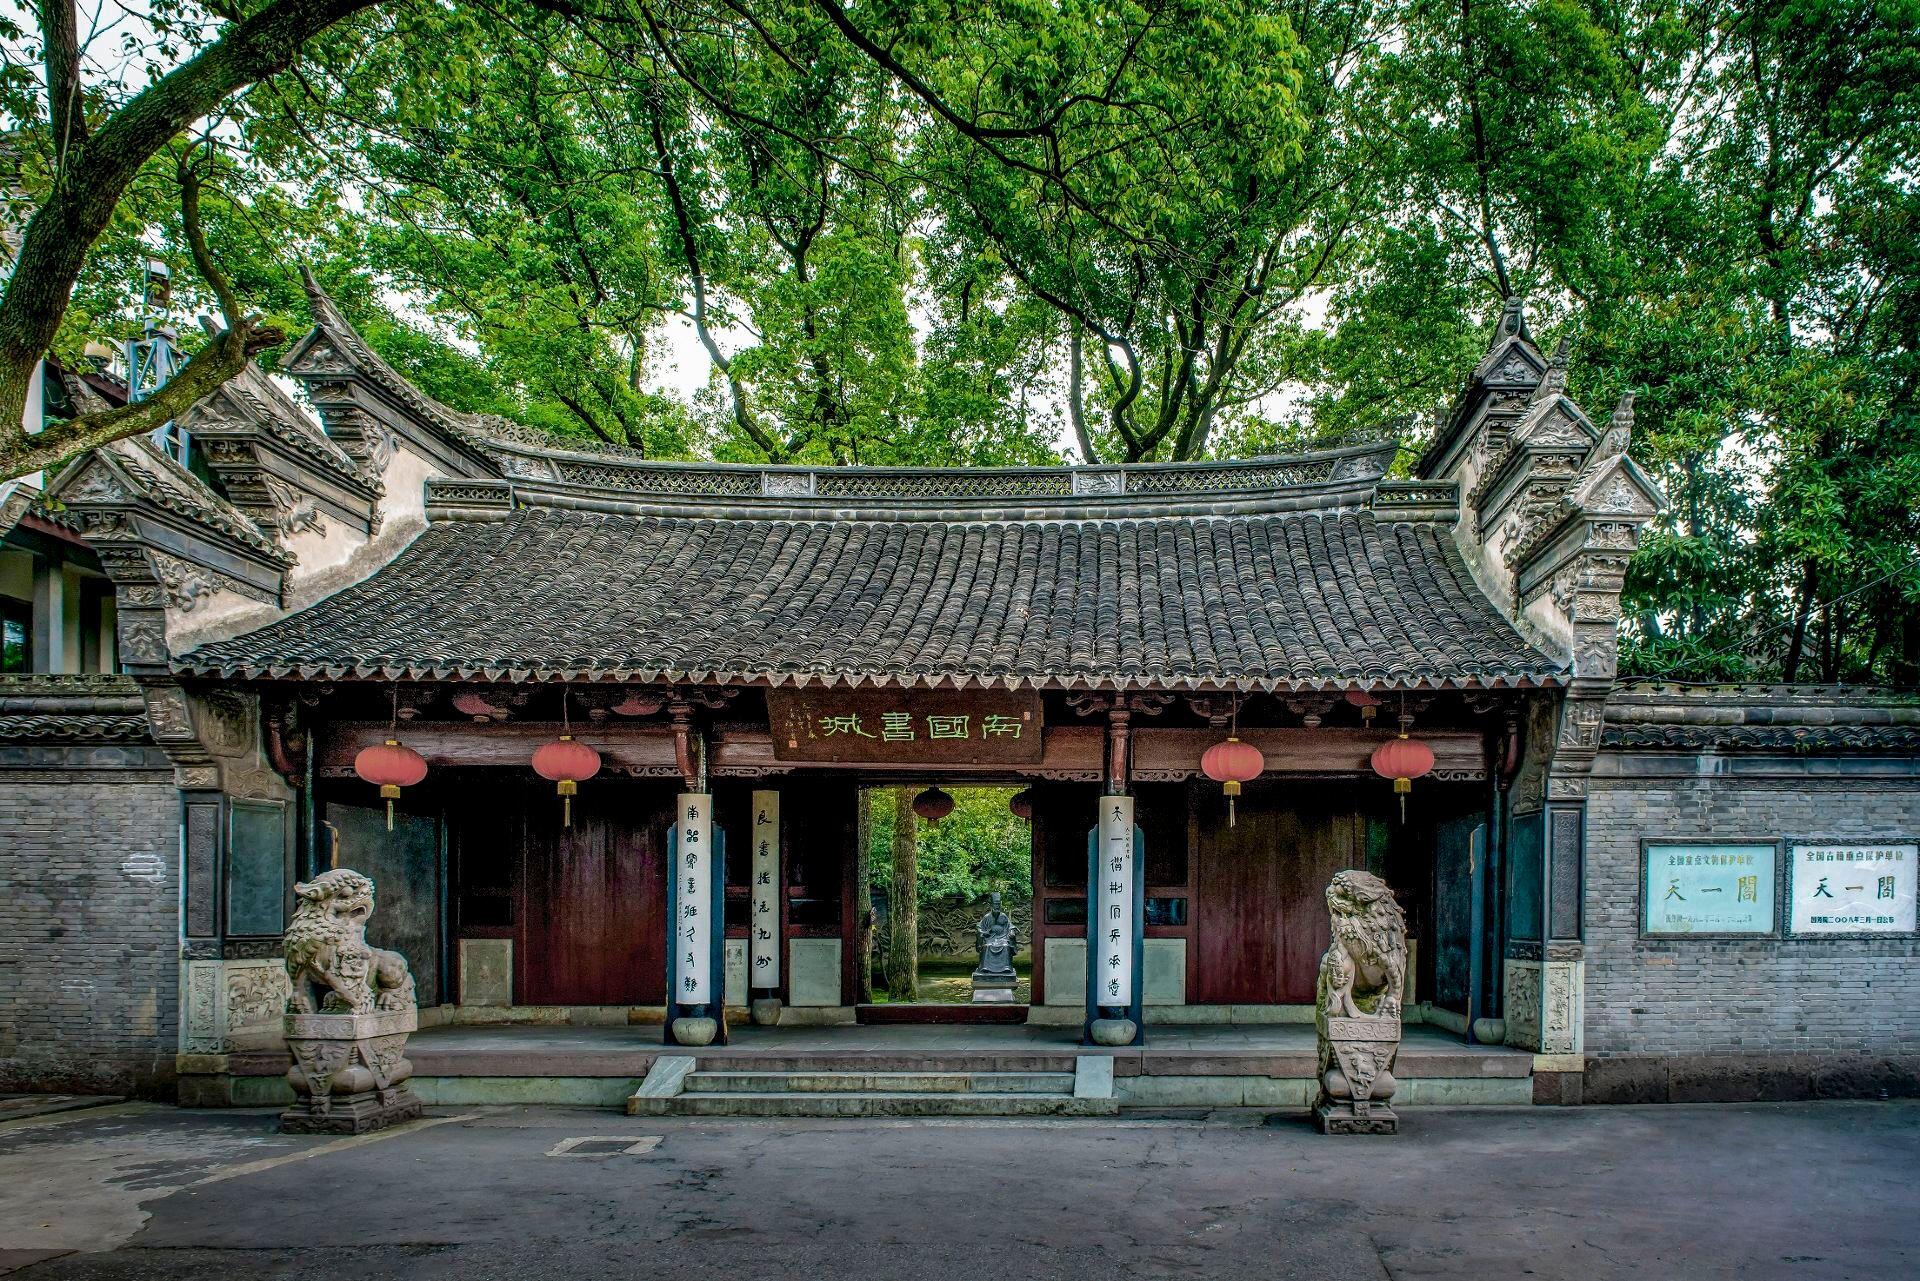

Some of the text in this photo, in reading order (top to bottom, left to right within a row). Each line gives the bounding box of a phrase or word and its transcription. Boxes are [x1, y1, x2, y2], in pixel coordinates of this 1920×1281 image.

[818, 711, 1024, 743] 南國書城
[1664, 875, 1758, 903] 天一閣
[1812, 875, 1896, 901] 天一閣
